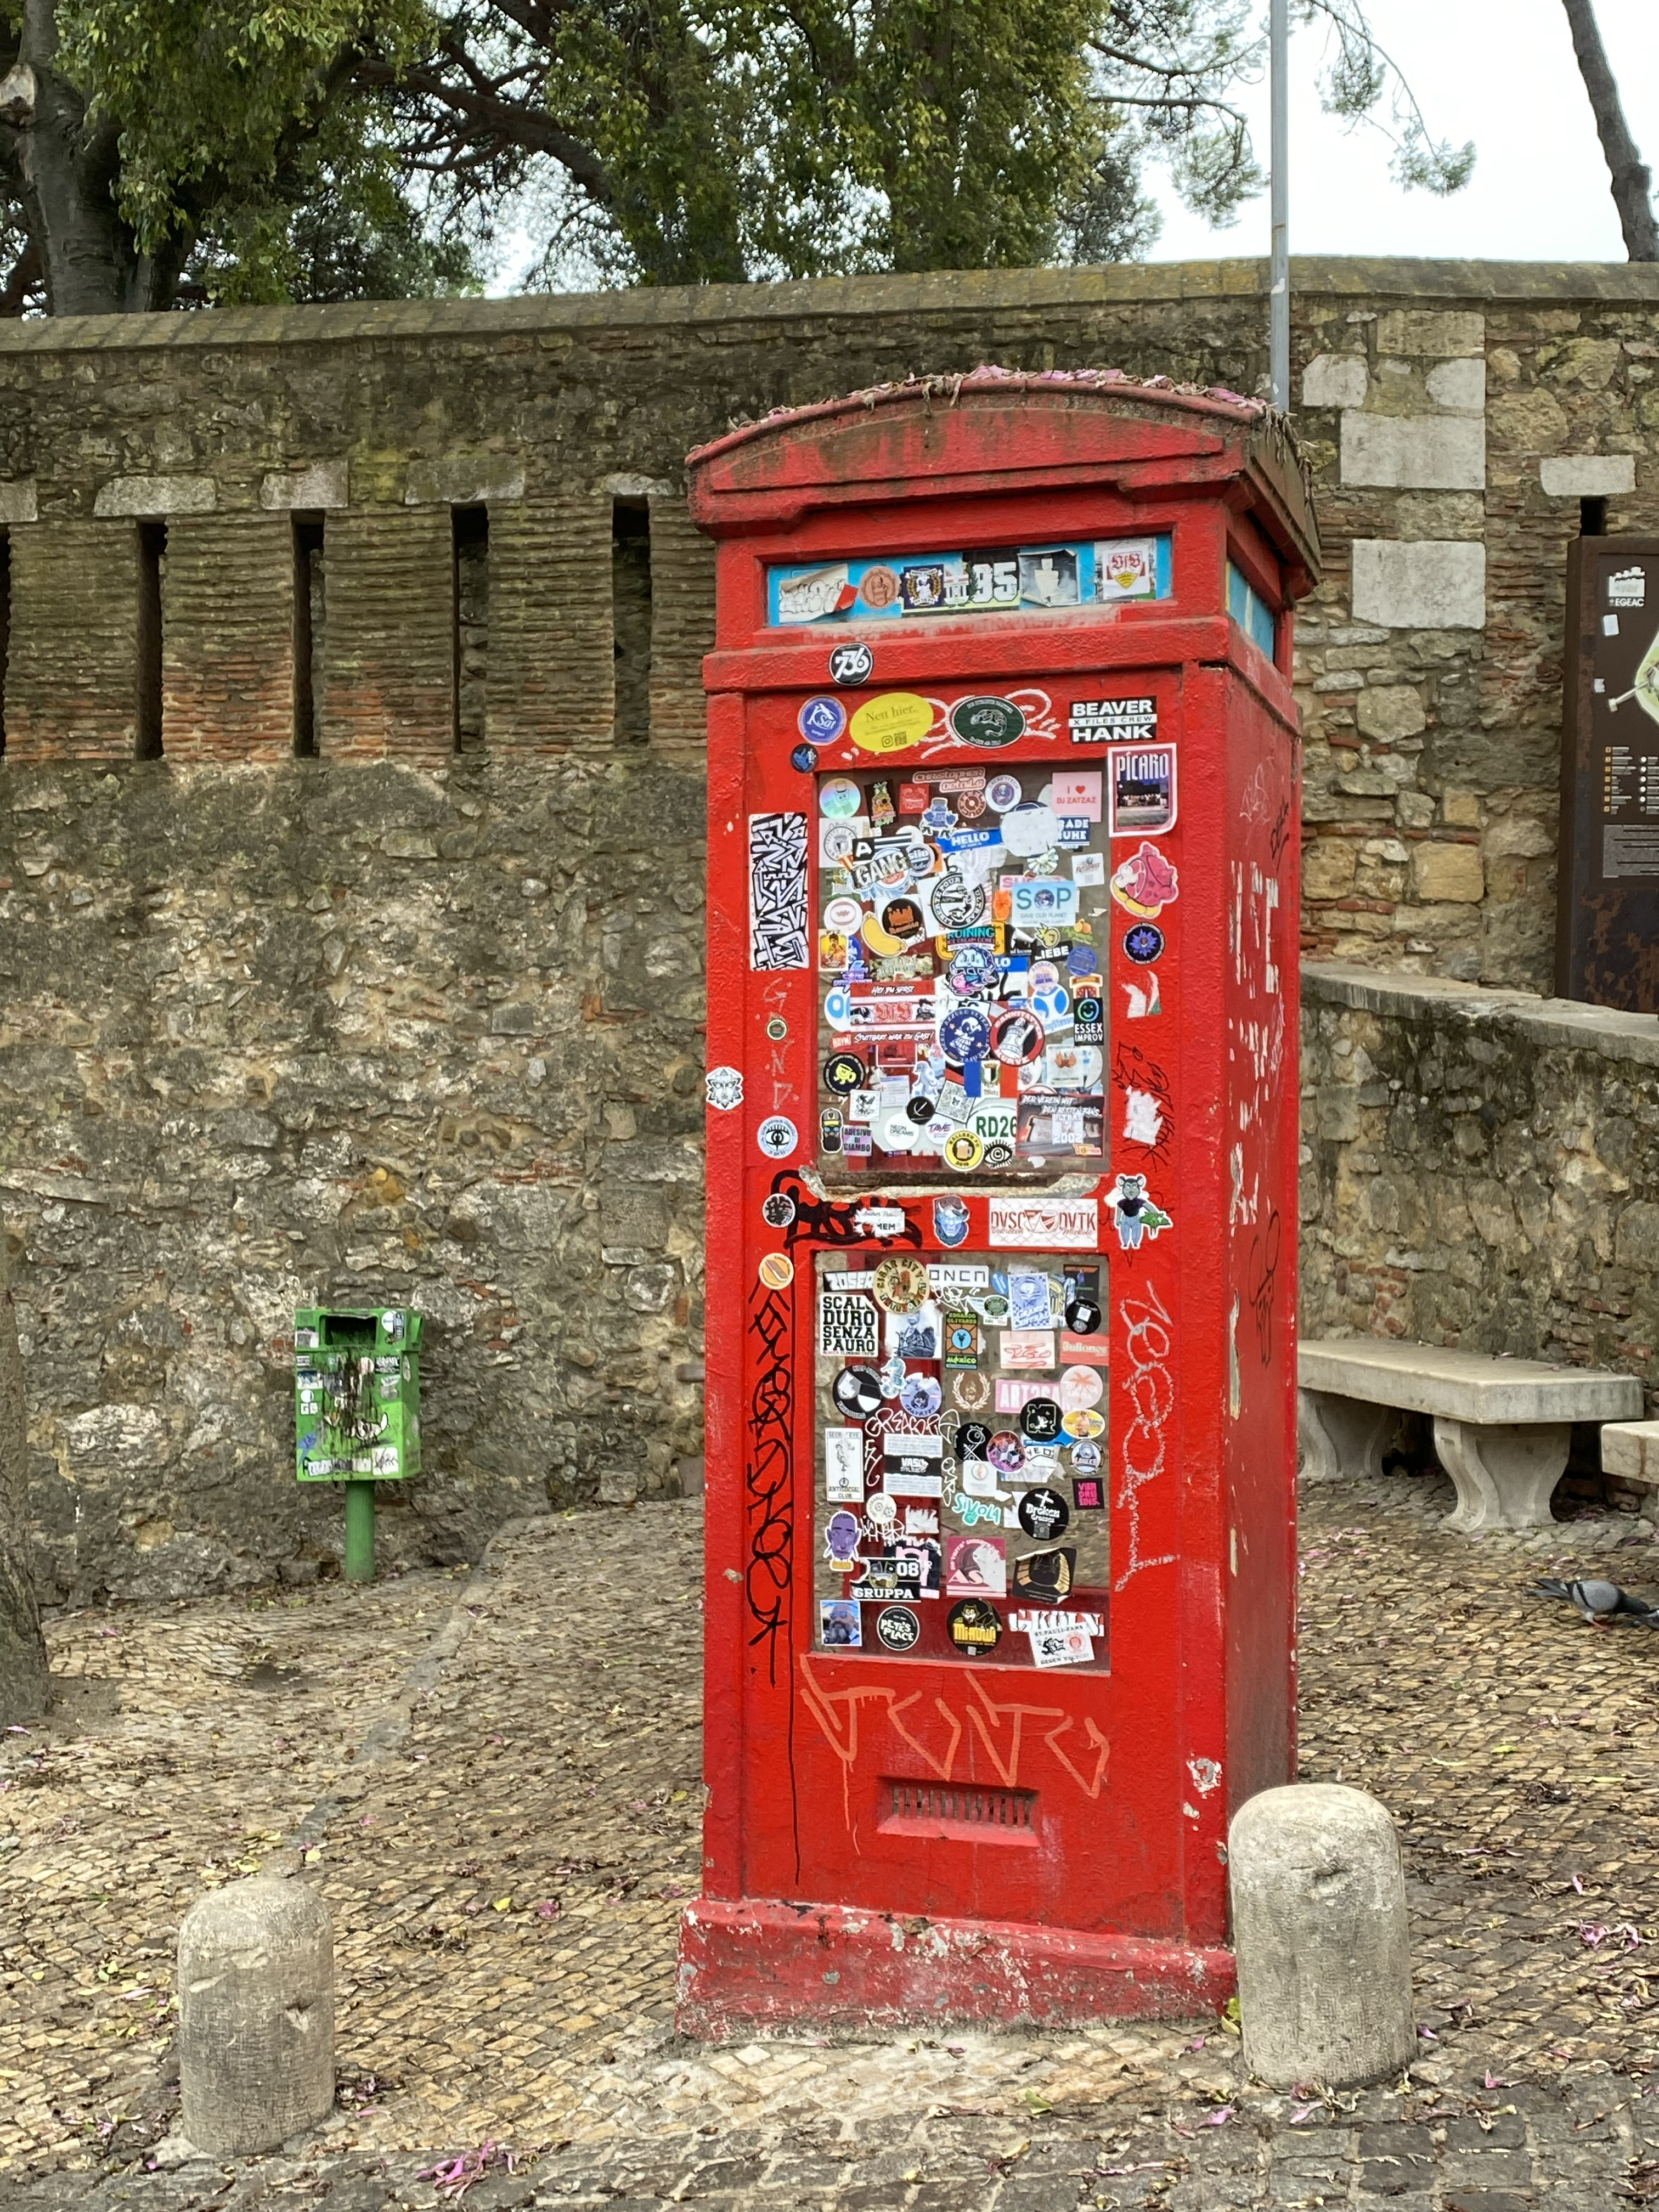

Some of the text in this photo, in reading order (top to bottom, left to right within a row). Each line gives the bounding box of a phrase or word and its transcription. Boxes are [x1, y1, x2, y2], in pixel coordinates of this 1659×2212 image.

[1615, 598, 1645, 607] EGEAC
[1072, 699, 1153, 717] BEAVER
[865, 712, 890, 723] Nett
[1073, 725, 1153, 742] HANK
[951, 832, 990, 846] HELLO
[856, 852, 909, 889] GANG
[994, 1011, 1042, 1040] CANNSTATTER
[1074, 1023, 1103, 1034] ESSEX
[994, 1048, 1031, 1065] KURVE
[844, 1128, 871, 1137] ADESIVO
[843, 1143, 871, 1152] GIAMBO
[991, 1211, 1096, 1231] DVSC DVTK
[900, 1258, 924, 1278] CITY
[823, 1310, 875, 1327] DURO
[823, 1325, 875, 1339] SENZA
[823, 1339, 875, 1352] PAURO
[953, 1494, 1001, 1523] SIVOLA
[896, 1562, 919, 1577] 08
[853, 1588, 915, 1599] GRUPPA
[881, 1618, 911, 1632] PETE'S
[883, 1628, 915, 1641] PLACE
